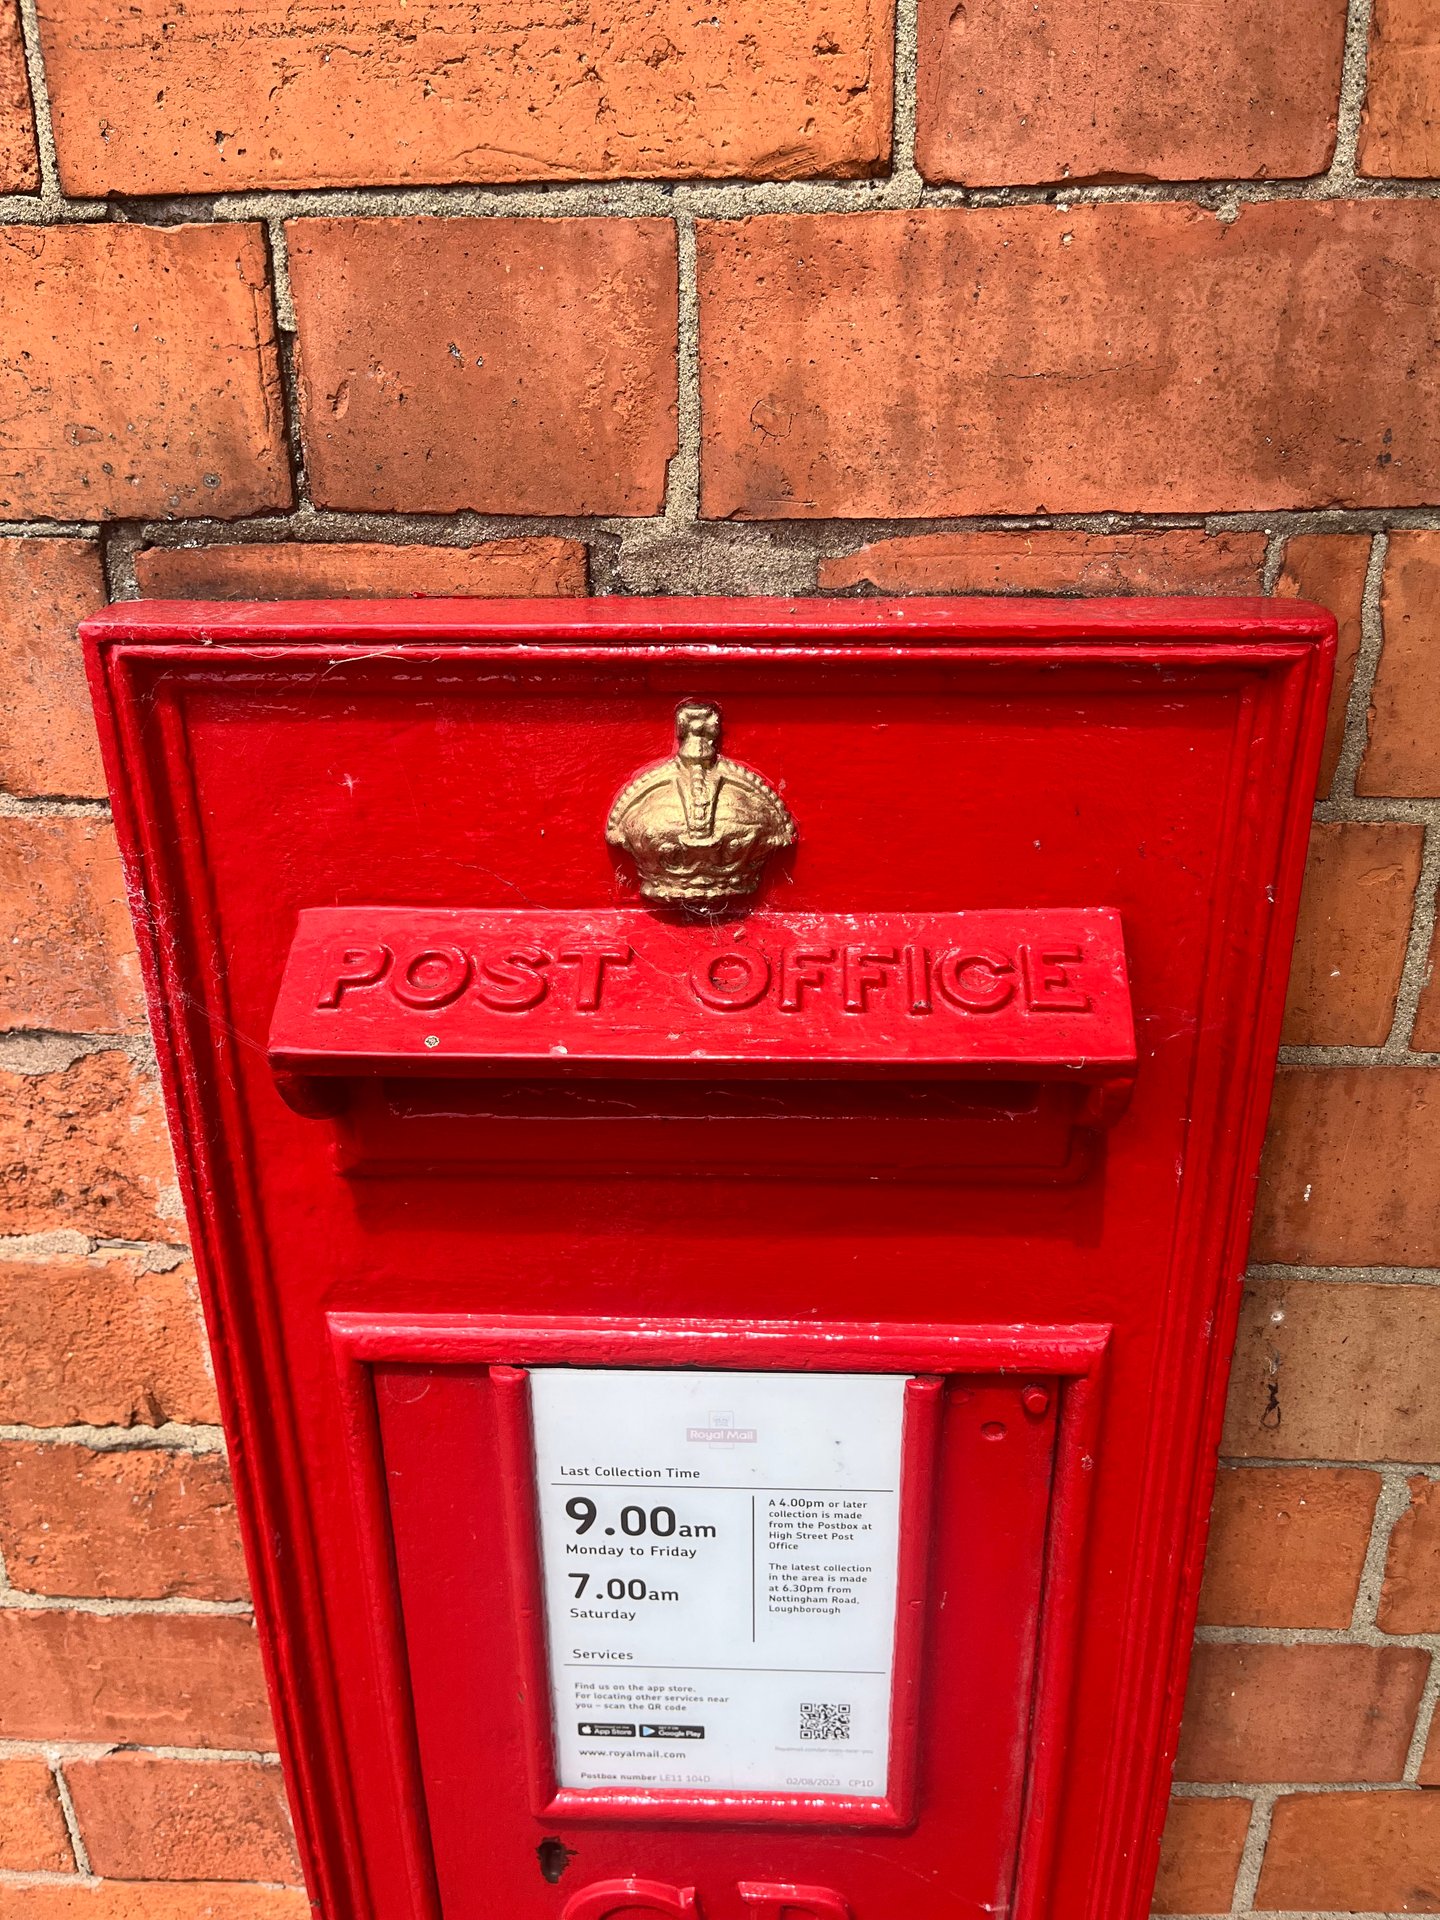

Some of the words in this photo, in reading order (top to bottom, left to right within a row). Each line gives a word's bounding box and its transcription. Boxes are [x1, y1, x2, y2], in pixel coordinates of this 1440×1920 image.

[316, 942, 634, 1014] POST
[690, 944, 1096, 1016] OFFICE
[690, 1429, 723, 1442] Royal
[727, 1430, 754, 1441] Mail
[560, 1466, 590, 1476] Last
[594, 1466, 662, 1478] Collection
[665, 1467, 701, 1479] Time
[768, 1498, 776, 1507] A
[779, 1498, 825, 1509] 4.00pm
[843, 1500, 868, 1509] later
[565, 1496, 717, 1538] 9.00am
[768, 1510, 818, 1518] collection
[821, 1510, 830, 1519] is
[834, 1511, 863, 1520] made
[768, 1520, 794, 1529] from
[797, 1521, 814, 1529] the
[817, 1521, 859, 1530] Postbox
[768, 1531, 793, 1541] High
[796, 1531, 828, 1540] Street
[831, 1532, 854, 1541] Post
[768, 1541, 799, 1550] Office
[566, 1544, 624, 1557] Monday
[630, 1546, 645, 1556] to
[650, 1546, 697, 1559] Friday
[768, 1563, 788, 1571] The
[791, 1563, 820, 1572] latest
[823, 1564, 872, 1573] collection
[768, 1573, 778, 1581] in
[827, 1574, 836, 1582] is
[840, 1575, 868, 1583] made
[567, 1572, 680, 1601] 7.00am
[768, 1584, 779, 1592] at
[782, 1584, 824, 1594] 6.30pm
[827, 1585, 852, 1594] from
[768, 1594, 828, 1604] Nottingham
[831, 1595, 860, 1605] Road,
[570, 1608, 637, 1621] Saturday
[768, 1605, 841, 1615] Loughborough
[572, 1649, 634, 1660] Services
[574, 1682, 595, 1690] Find
[593, 1693, 632, 1702] locating
[635, 1694, 662, 1702] other
[664, 1695, 704, 1703] services
[593, 1728, 611, 1737] App
[658, 1729, 685, 1738] Google
[686, 1730, 702, 1739] Play
[578, 1749, 686, 1759] www.royalmail.com
[580, 1772, 617, 1780] Postbox
